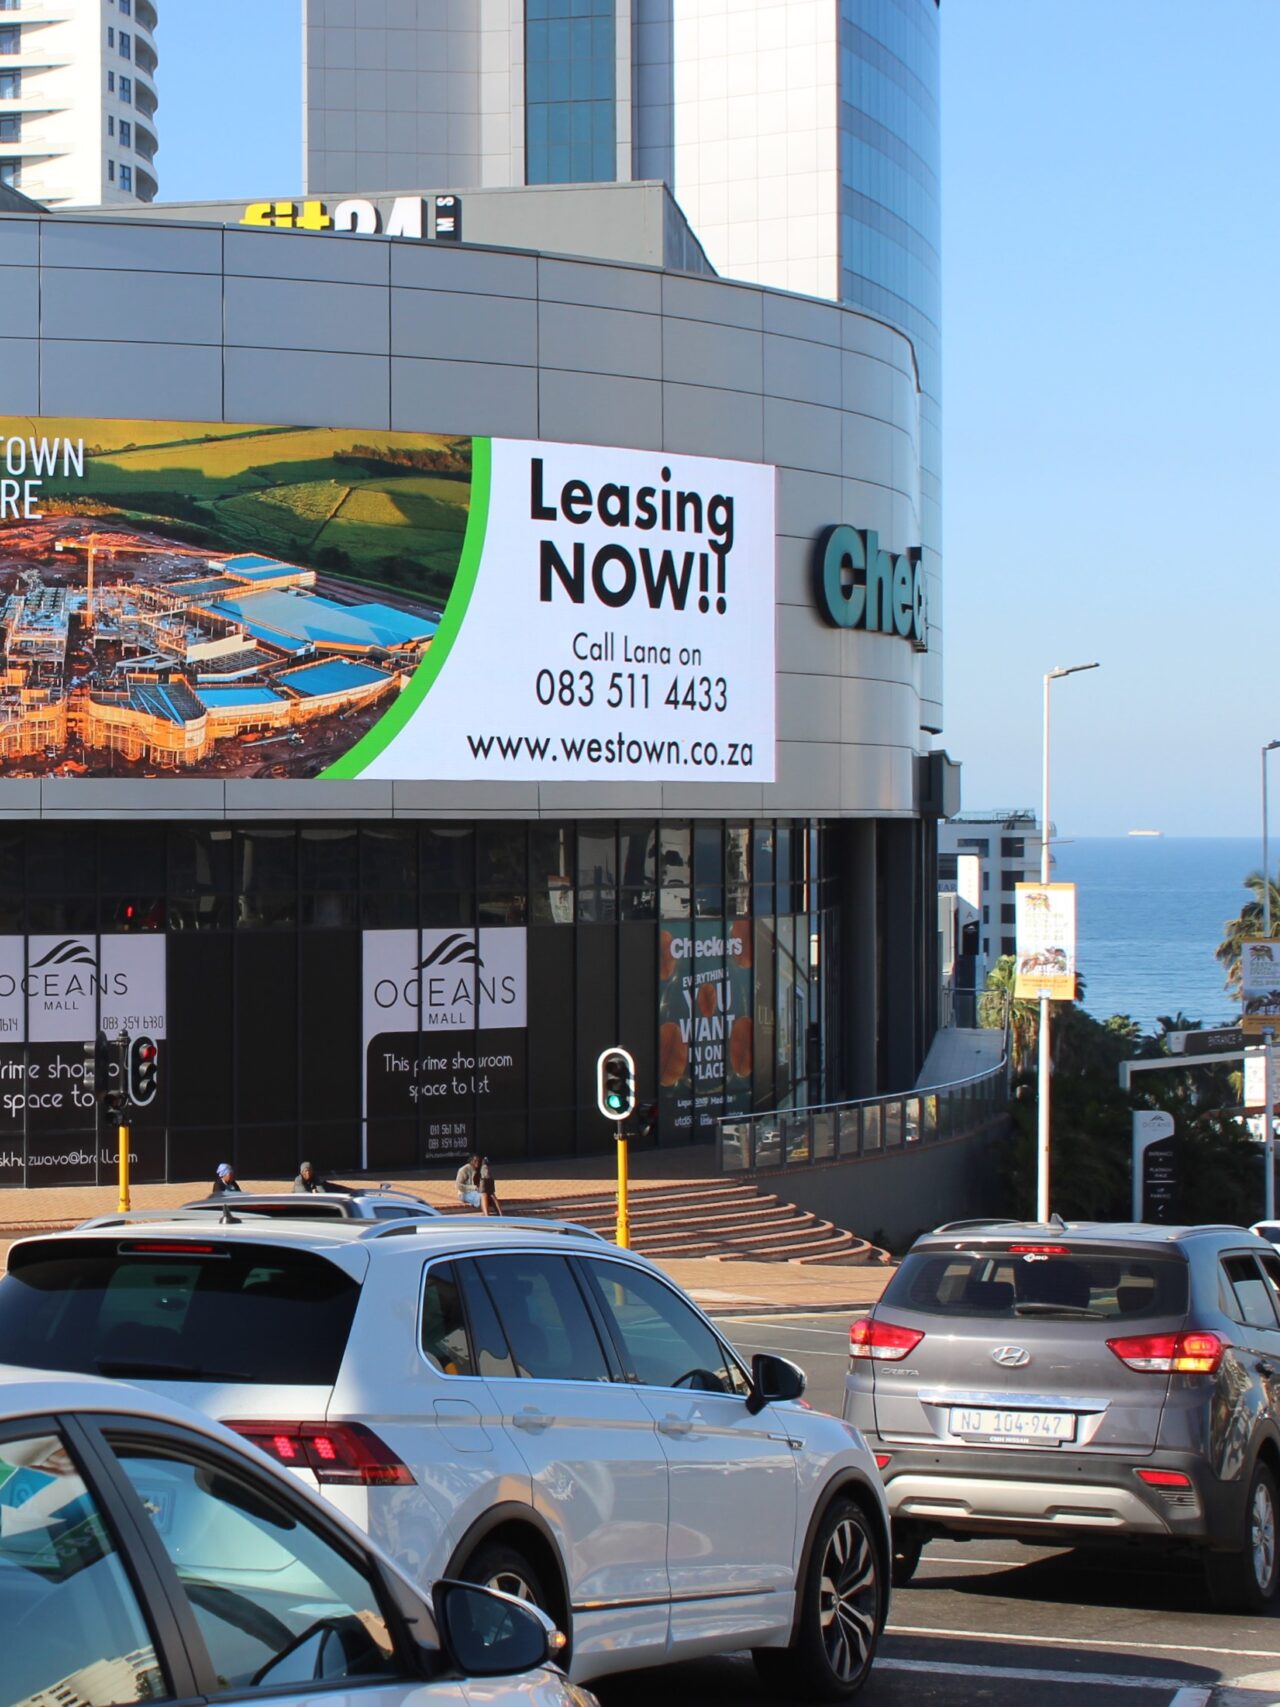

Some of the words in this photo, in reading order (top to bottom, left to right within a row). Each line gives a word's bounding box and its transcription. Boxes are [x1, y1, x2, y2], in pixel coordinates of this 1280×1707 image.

[530, 457, 734, 555] Leasing
[573, 631, 615, 663] Call
[624, 634, 671, 665] Lana
[678, 644, 702, 667] on
[535, 668, 594, 706] 083
[606, 672, 650, 709] 511
[664, 676, 728, 712] 4433
[466, 731, 753, 767] www.westown.co.za
[374, 976, 516, 1008] OCEANS
[44, 1001, 79, 1011] MALL
[0, 1017, 18, 1032] 1614
[102, 1016, 119, 1030] 083
[122, 1016, 140, 1030] 354
[428, 1012, 467, 1025] MALL
[383, 1053, 410, 1073] This
[452, 1076, 468, 1095] to
[3, 1092, 64, 1118] space
[71, 1084, 95, 1108] to
[880, 1367, 920, 1376] CRETA
[961, 1412, 982, 1431] NJ
[993, 1412, 1062, 1435] 104-947
